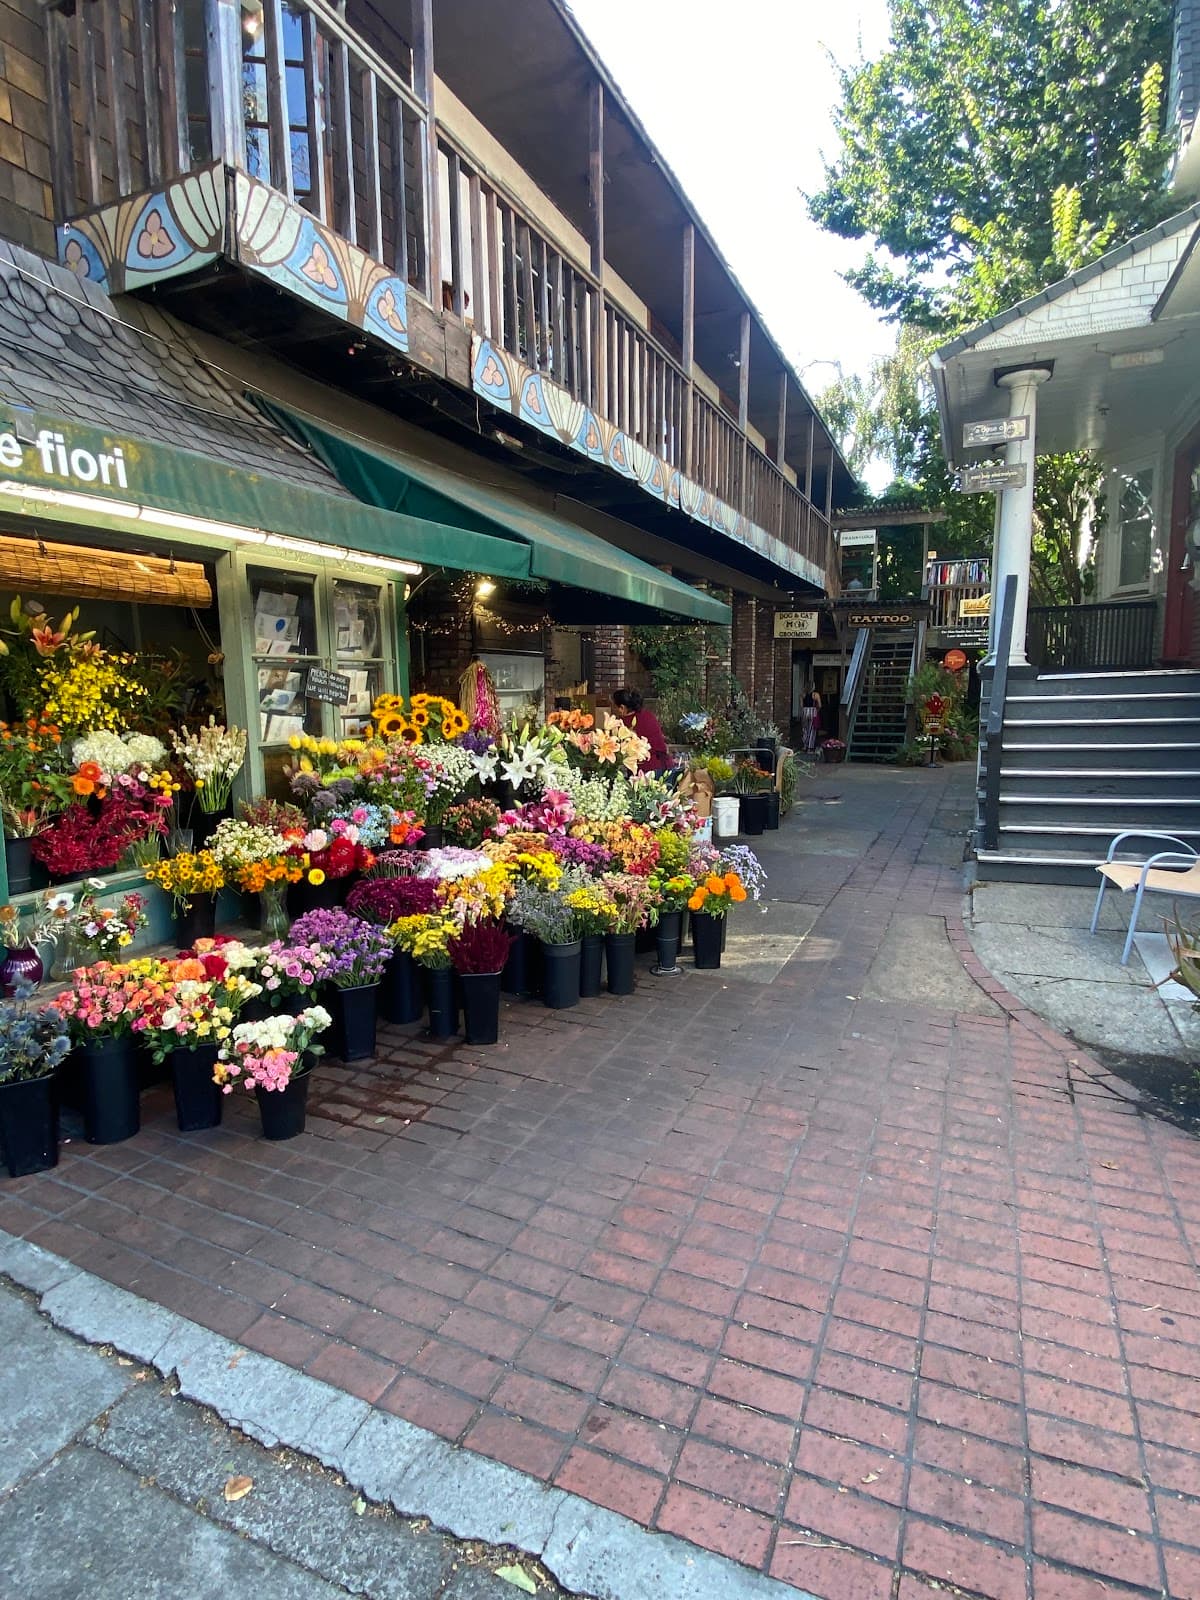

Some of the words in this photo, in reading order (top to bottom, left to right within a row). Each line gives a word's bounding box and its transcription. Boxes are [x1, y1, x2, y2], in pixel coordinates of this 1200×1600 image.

[36, 430, 128, 488] fiori
[779, 612, 793, 620] DOG
[801, 612, 815, 620] CAT
[851, 615, 910, 623] TATTOO
